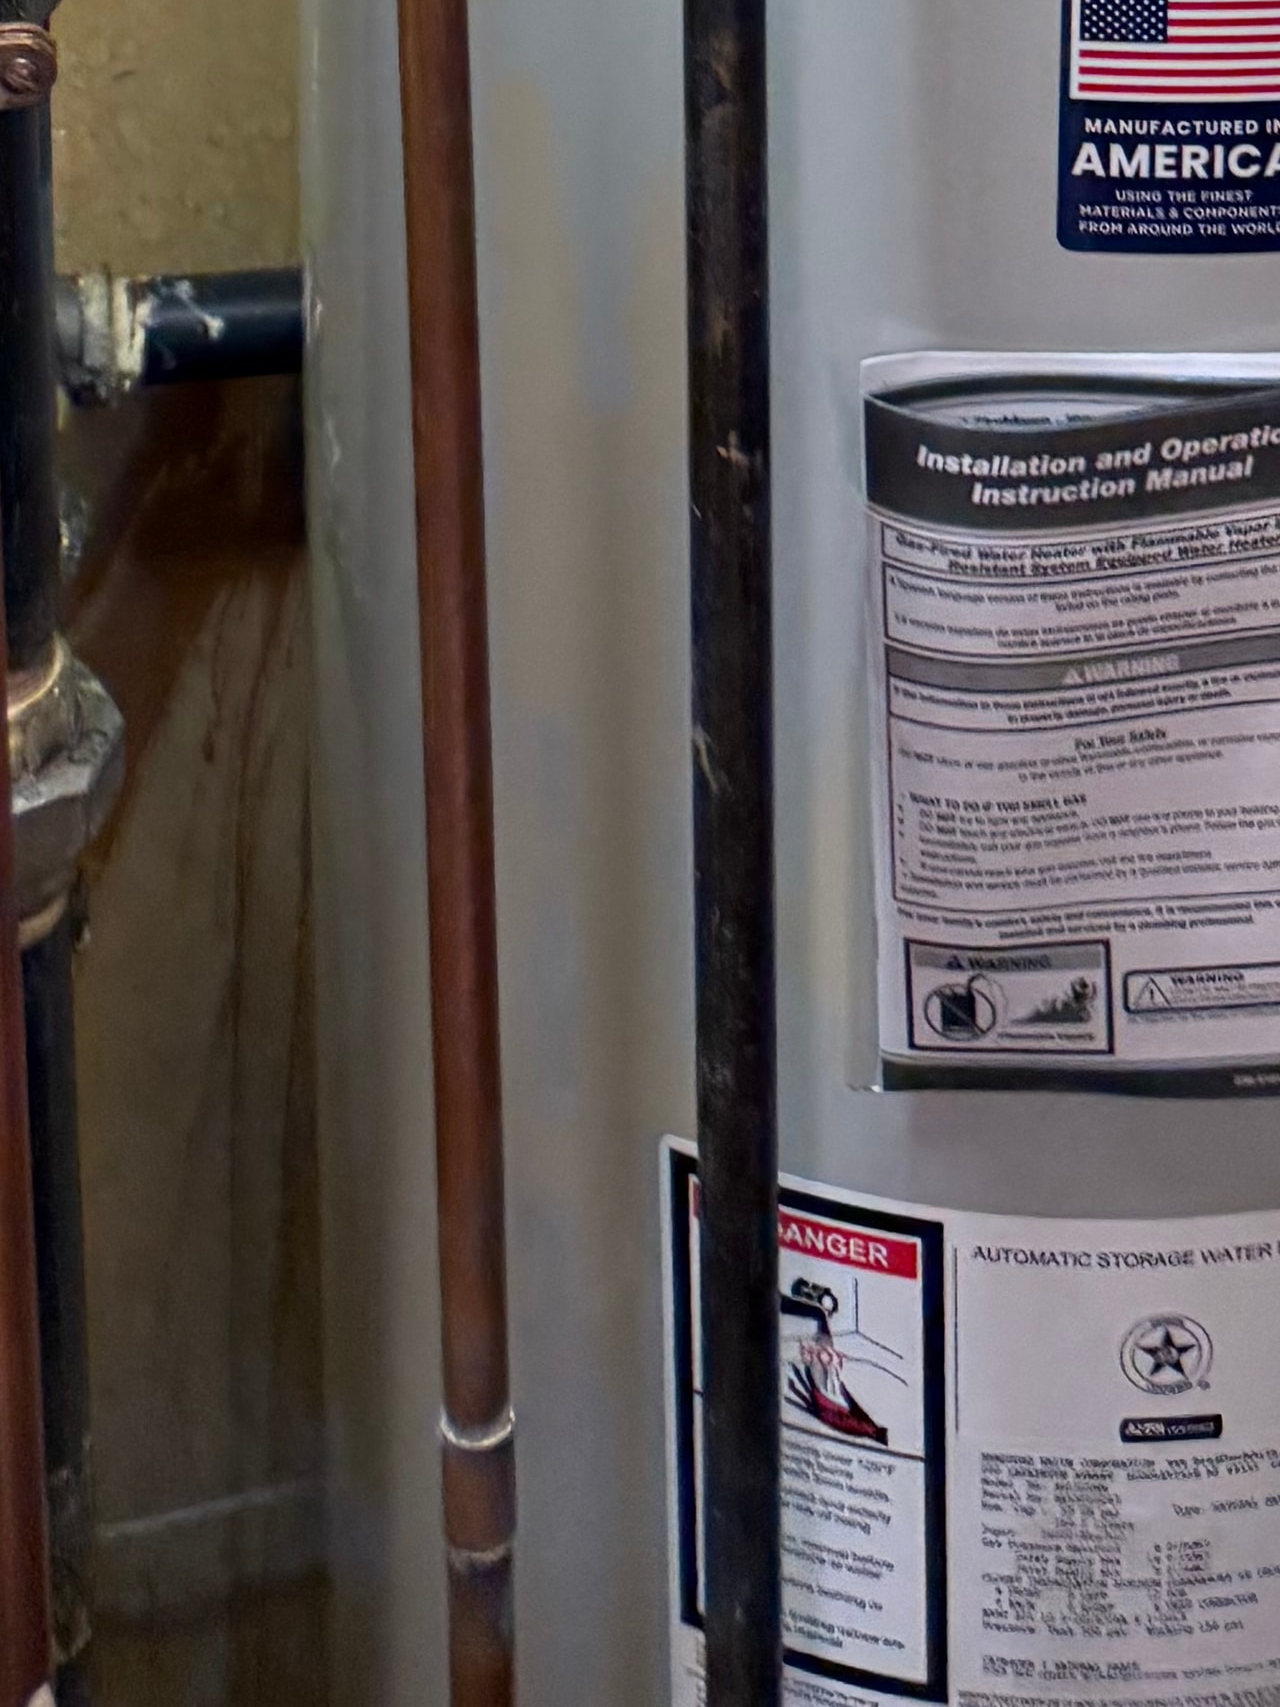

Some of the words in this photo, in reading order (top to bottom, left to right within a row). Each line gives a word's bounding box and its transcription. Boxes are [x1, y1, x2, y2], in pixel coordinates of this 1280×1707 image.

[1083, 117, 1259, 136] MANUFACTURED
[1115, 189, 1162, 203] USING
[1168, 189, 1196, 203] THE
[1200, 189, 1254, 203] FINEST
[1079, 204, 1165, 220] MATERIALS
[1078, 220, 1123, 234] FROM
[1126, 221, 1194, 236] AROUND
[1198, 222, 1227, 236] THE
[917, 444, 1086, 478] Installation
[1094, 445, 1152, 471] and
[971, 475, 1136, 507] Instruction
[1145, 455, 1254, 491] Manual
[1083, 653, 1180, 684] WARNING
[778, 1221, 889, 1269] ANGER
[972, 1244, 1092, 1268] AUTOMATIC
[1097, 1249, 1195, 1270] STORAGE
[1201, 1244, 1273, 1267] WATER
